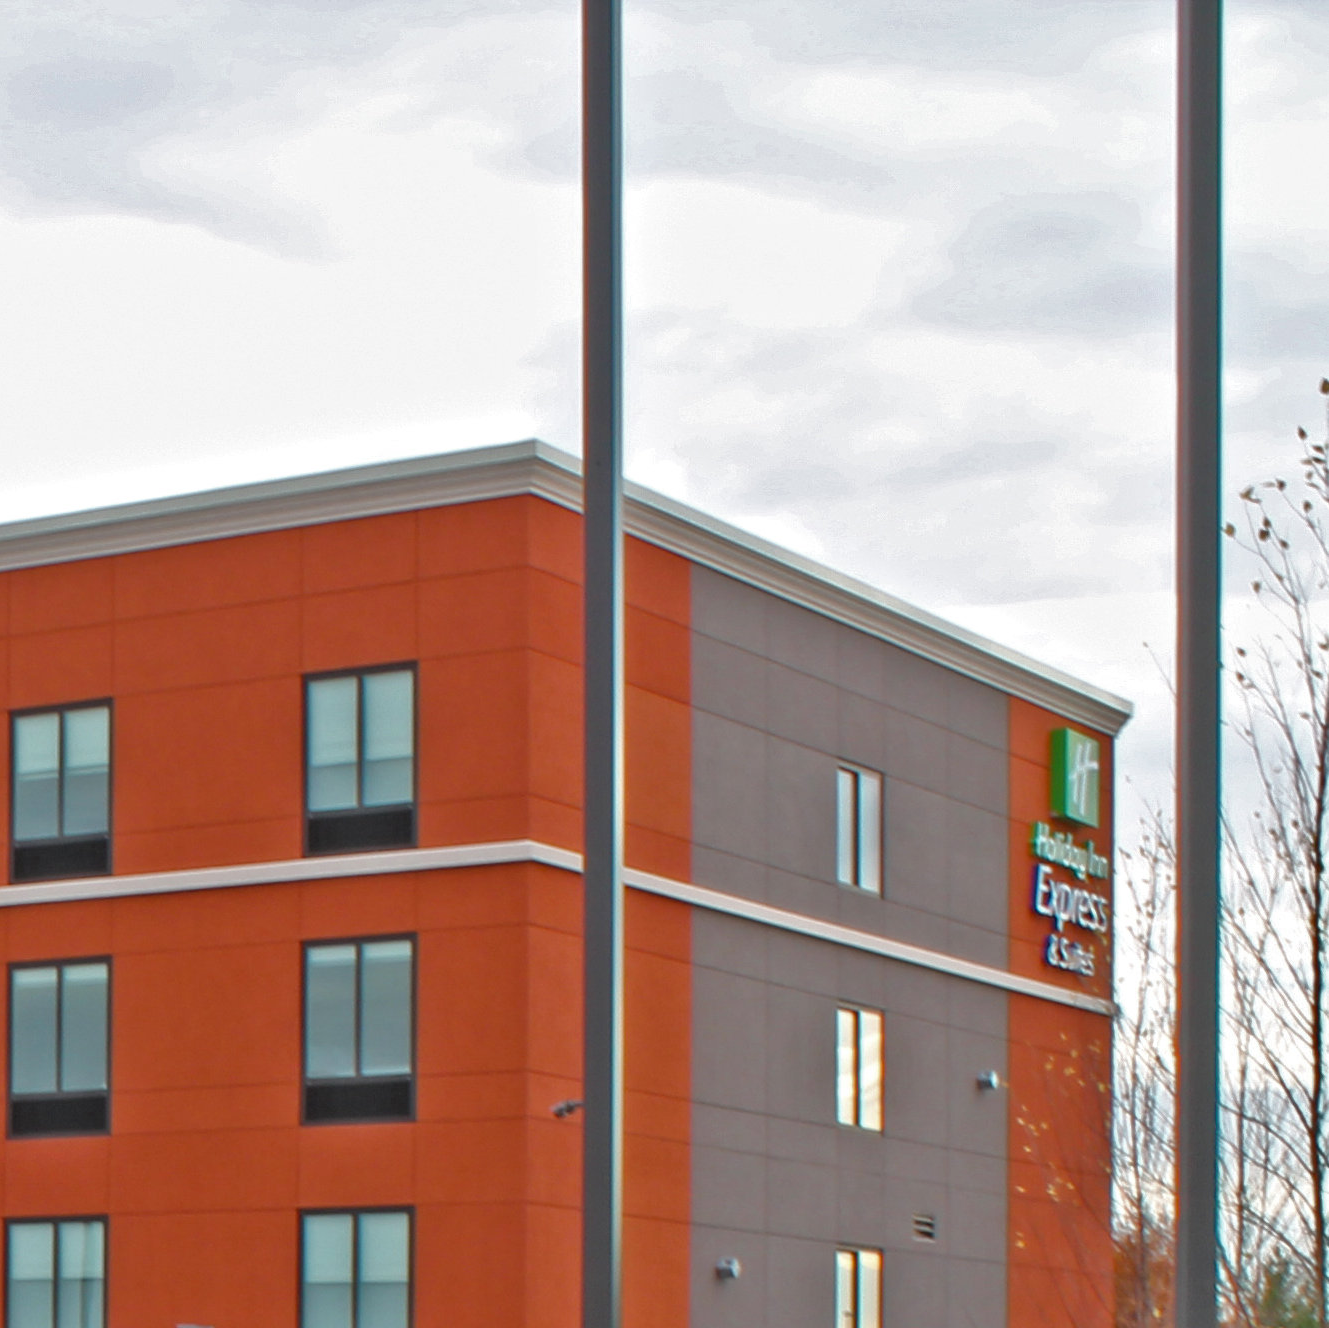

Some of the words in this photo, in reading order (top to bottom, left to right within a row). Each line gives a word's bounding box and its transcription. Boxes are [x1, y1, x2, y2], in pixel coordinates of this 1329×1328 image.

[1034, 821, 1088, 881] Holiday
[1086, 840, 1109, 879] Inn
[1033, 862, 1109, 933] Express
